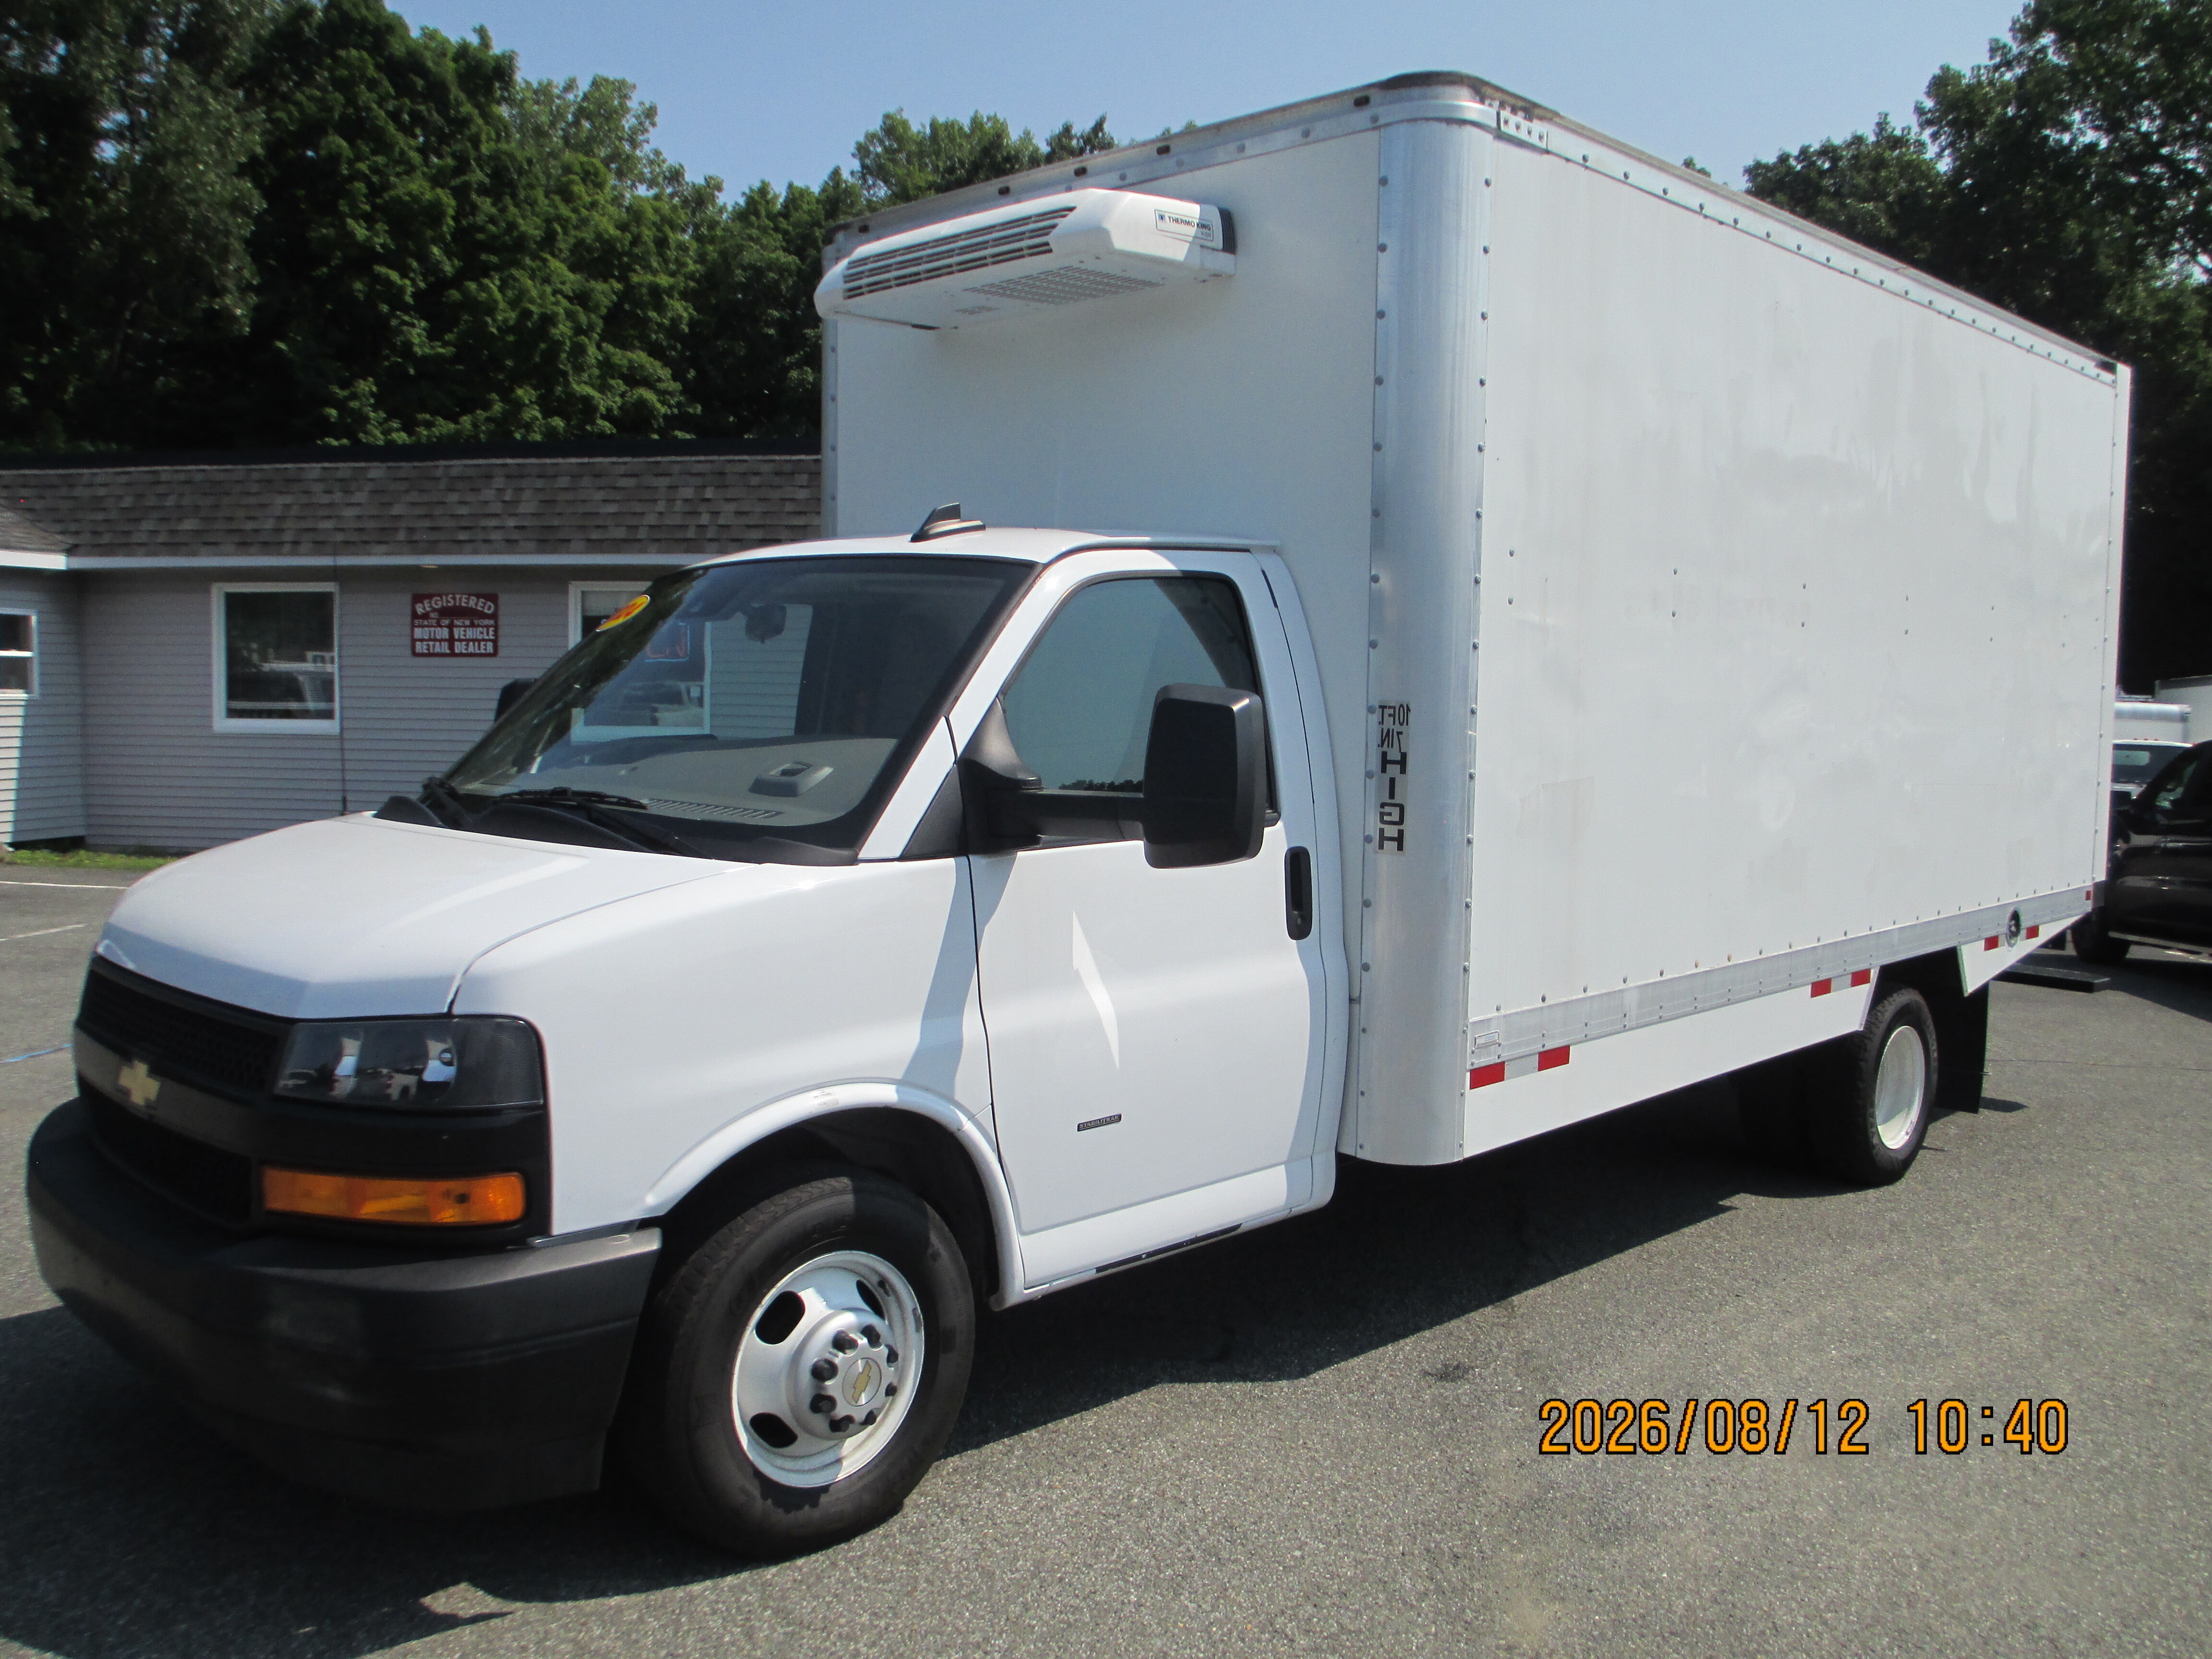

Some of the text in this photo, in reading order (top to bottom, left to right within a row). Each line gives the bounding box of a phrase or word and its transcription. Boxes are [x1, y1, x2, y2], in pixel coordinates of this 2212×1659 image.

[1168, 216, 1211, 230] THERMO KING
[414, 594, 495, 615] REGISTERED
[414, 627, 495, 639] MOTOR VEHICLE
[415, 641, 494, 653] RETAIL DEALER
[1080, 1115, 1119, 1129] STABILITRAK
